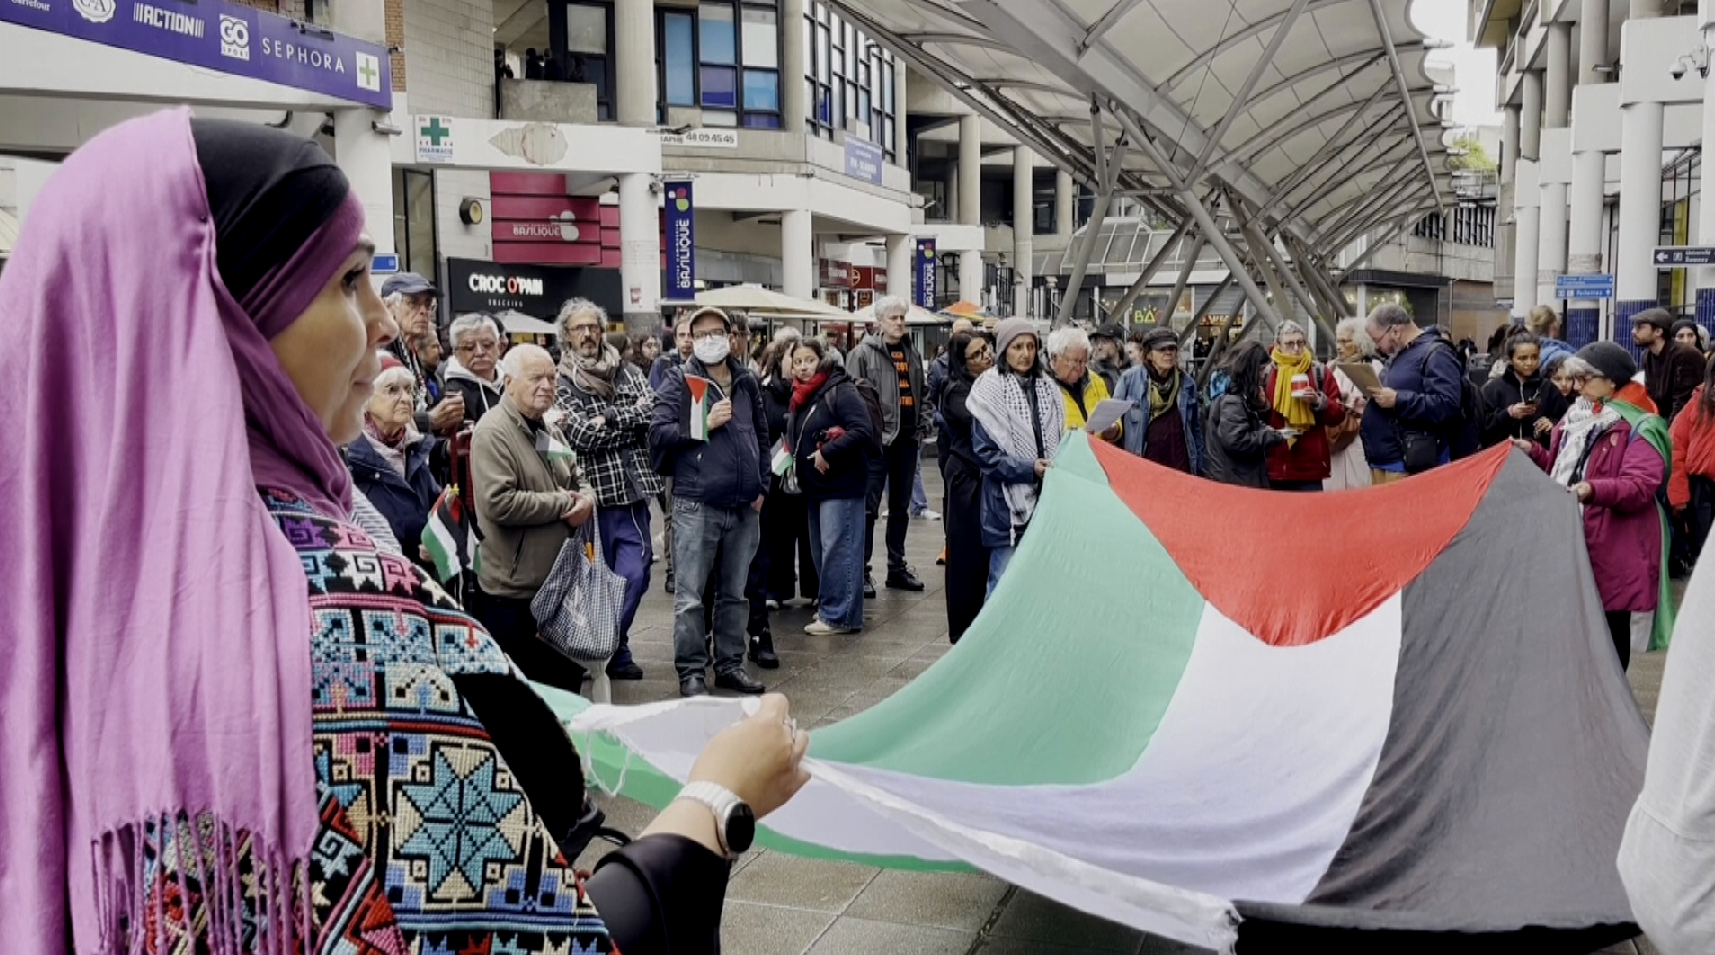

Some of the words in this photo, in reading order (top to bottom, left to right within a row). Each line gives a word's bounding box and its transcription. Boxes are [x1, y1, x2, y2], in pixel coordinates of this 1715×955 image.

[139, 6, 196, 38] ACTION
[219, 20, 249, 48] GO
[262, 37, 345, 74] SEPHORA
[513, 225, 560, 238] BASILIQUE
[679, 218, 692, 288] BASILIQUE
[468, 272, 506, 293] CROC
